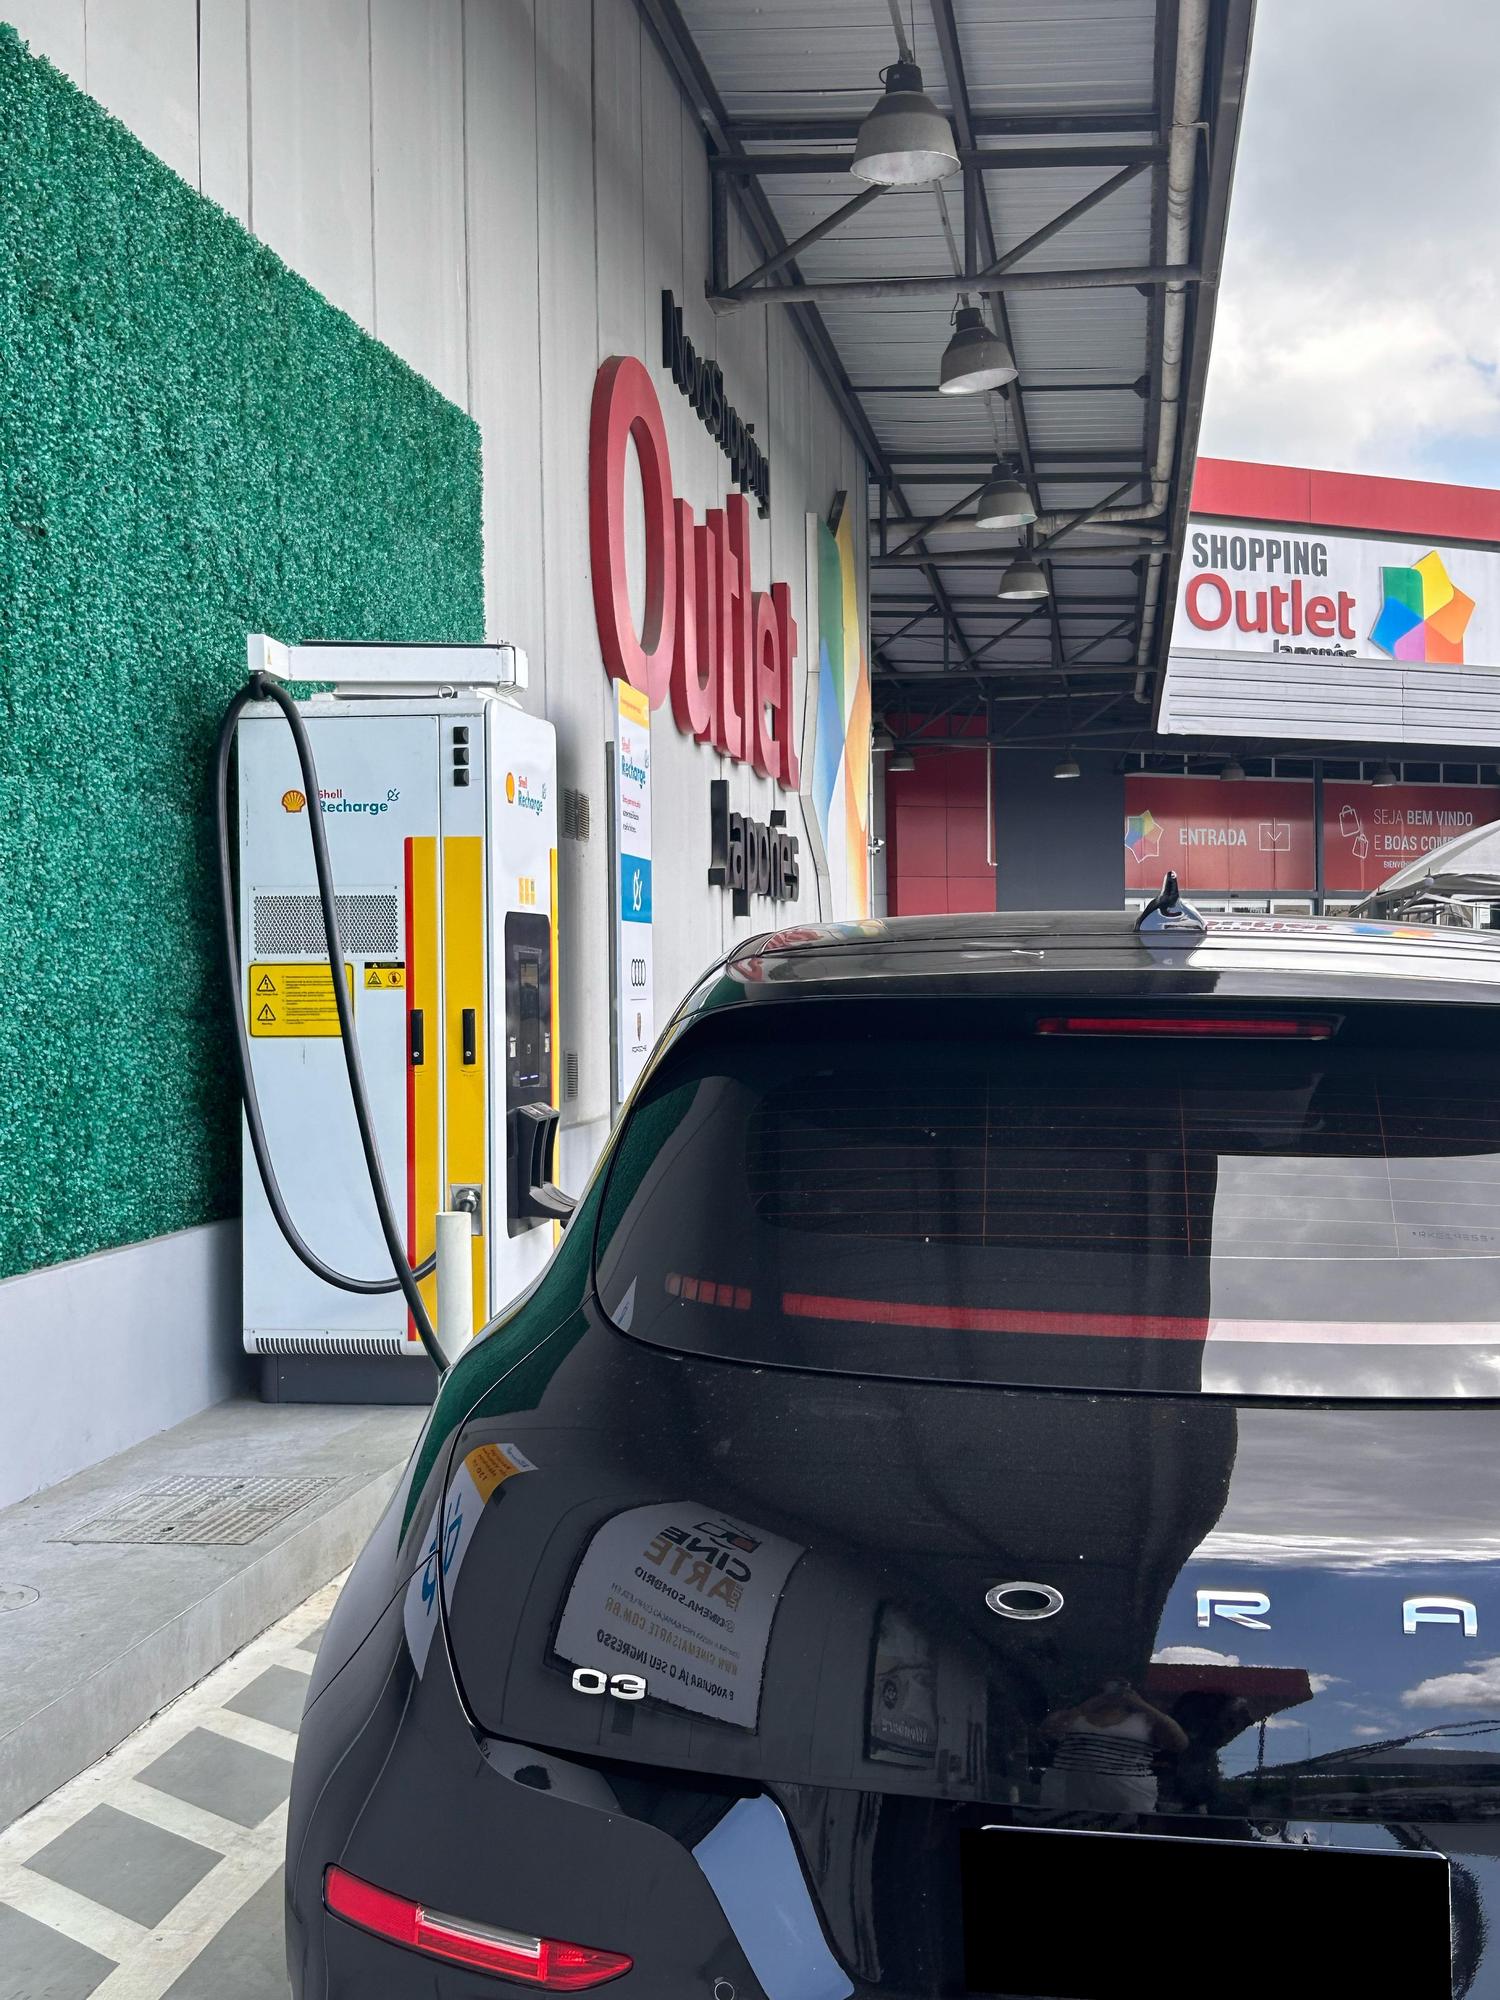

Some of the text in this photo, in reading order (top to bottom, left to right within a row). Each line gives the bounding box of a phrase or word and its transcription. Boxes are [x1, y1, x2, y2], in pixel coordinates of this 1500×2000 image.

[1192, 533, 1327, 577] SHOPPING
[589, 355, 799, 792] Outlet
[1185, 573, 1356, 639] Outlet
[317, 788, 343, 799] Shell
[518, 790, 543, 816] Recharge
[320, 799, 388, 815] Recharge
[1373, 808, 1473, 826] SEJA BEM VINDO
[1179, 828, 1247, 847] ENTRADA
[1374, 834, 1381, 850] E
[1384, 835, 1417, 851] BOAS
[572, 1668, 647, 1700] 03
